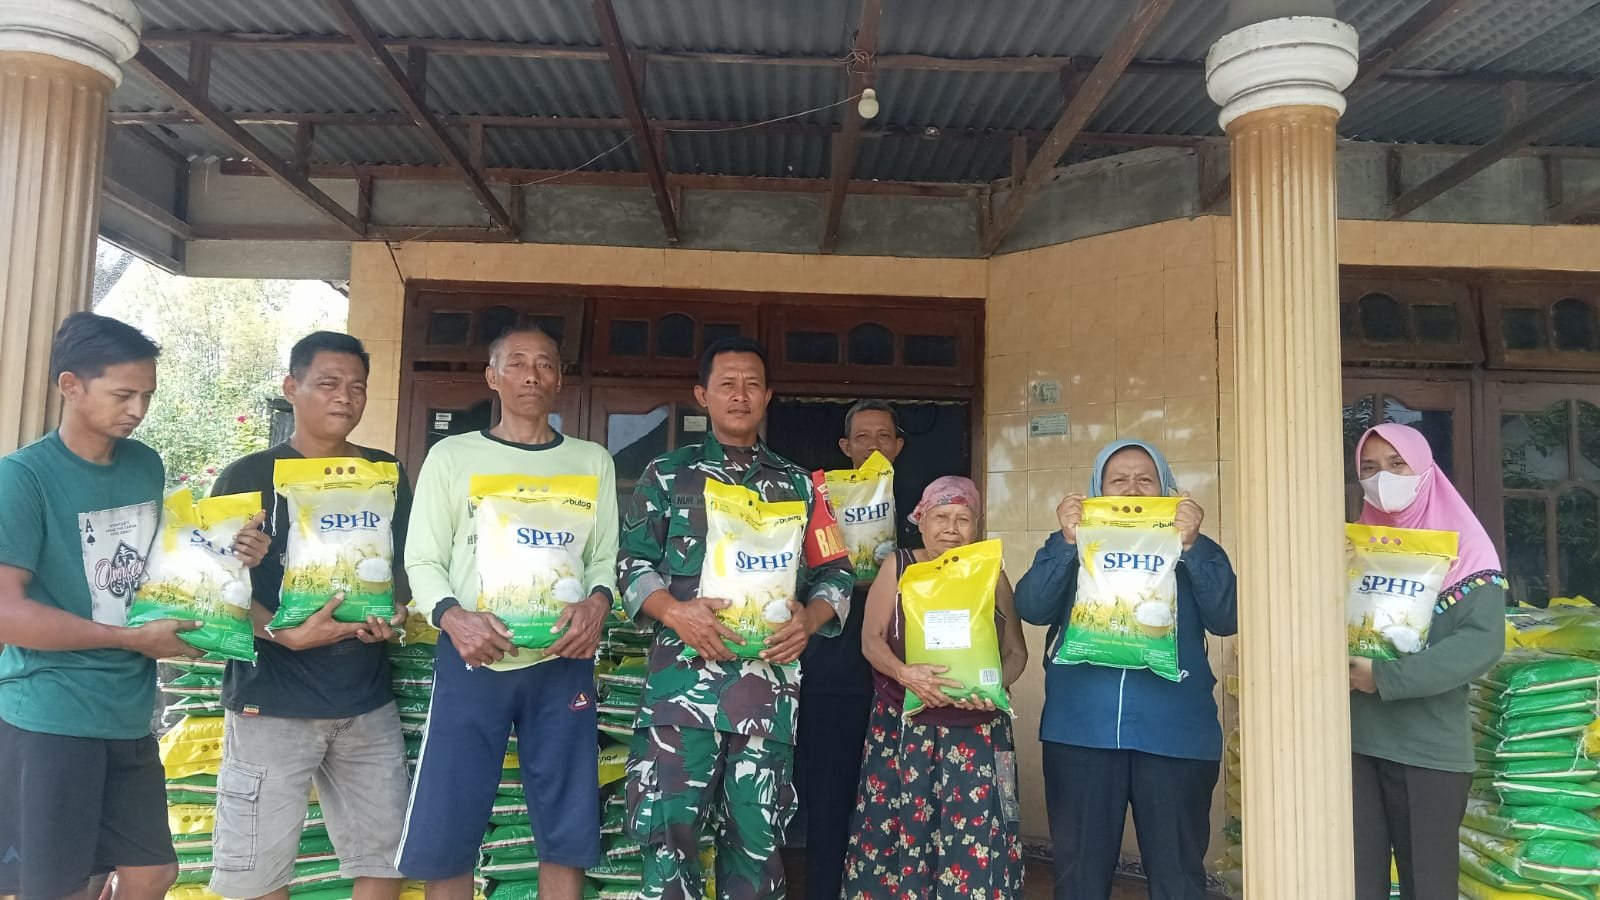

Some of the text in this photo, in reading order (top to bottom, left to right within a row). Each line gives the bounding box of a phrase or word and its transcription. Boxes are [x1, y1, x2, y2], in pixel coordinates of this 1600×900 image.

[569, 498, 592, 510] bulog
[677, 495, 694, 505] NUR
[844, 501, 890, 523] SPHP
[85, 518, 94, 533] A
[320, 510, 381, 530] SPHP
[516, 526, 575, 548] SPHP
[814, 523, 847, 558] BA
[735, 551, 794, 570] SPHP
[1103, 552, 1165, 573] SPHP
[331, 579, 340, 592] 5
[1358, 575, 1425, 598] SPHP
[528, 600, 538, 612] 5
[739, 620, 748, 632] 5
[1110, 619, 1119, 631] 5
[1359, 639, 1368, 650] 5
